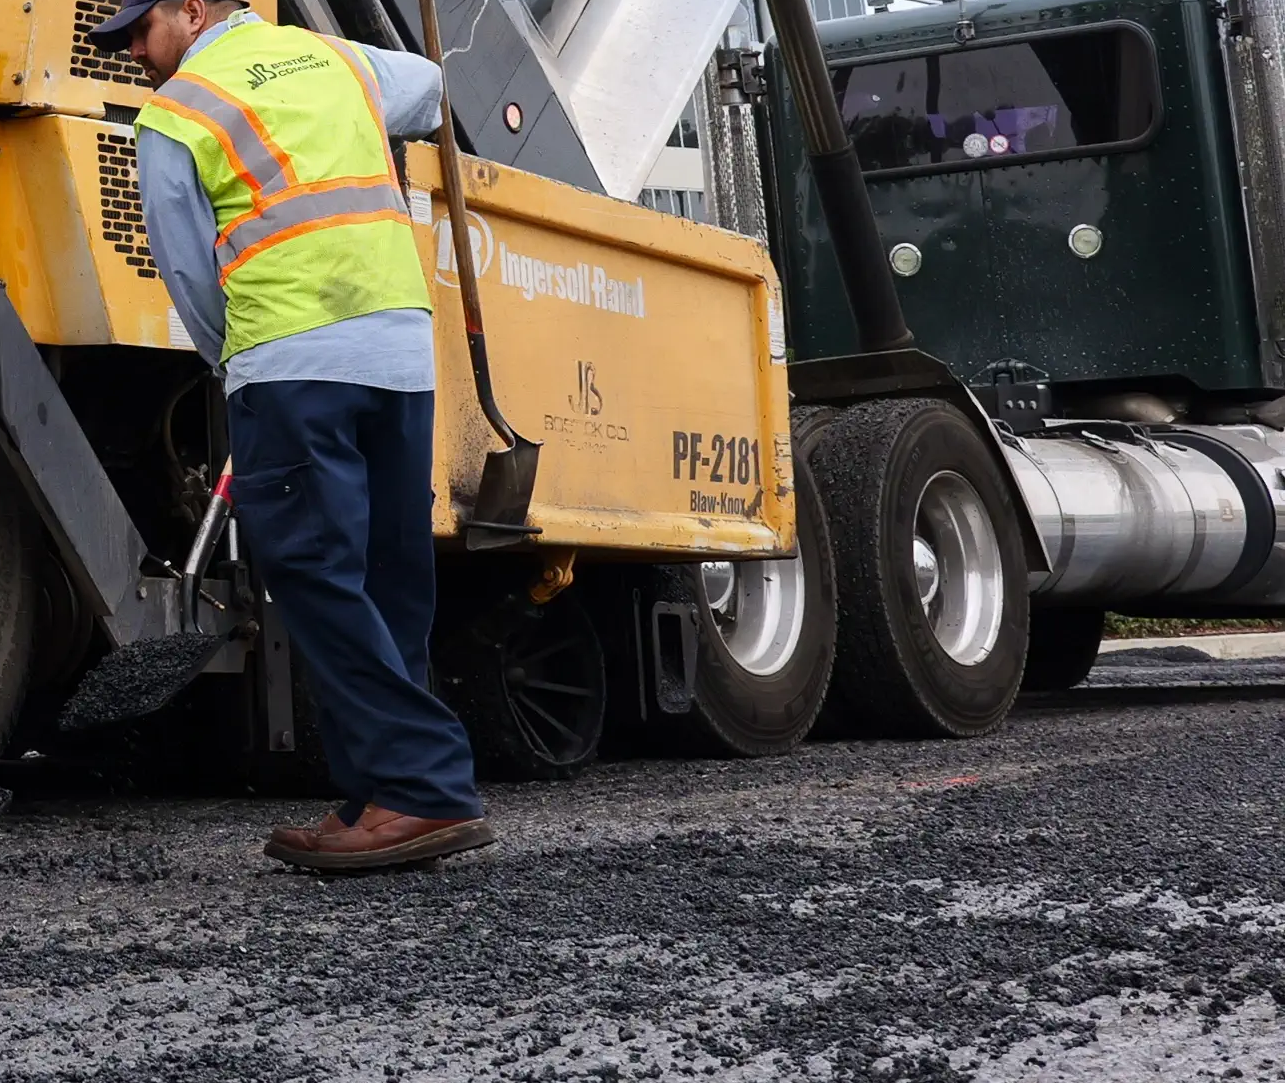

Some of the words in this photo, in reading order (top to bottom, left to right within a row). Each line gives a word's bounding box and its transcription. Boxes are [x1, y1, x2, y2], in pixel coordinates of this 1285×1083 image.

[271, 54, 317, 70] BOSTICK
[278, 60, 330, 77] COMPANY
[499, 241, 646, 319] Ingersoll-Rand
[544, 413, 604, 439] BOSCK
[672, 430, 763, 486] PF-2181
[690, 489, 747, 516] Blaw-Knox
